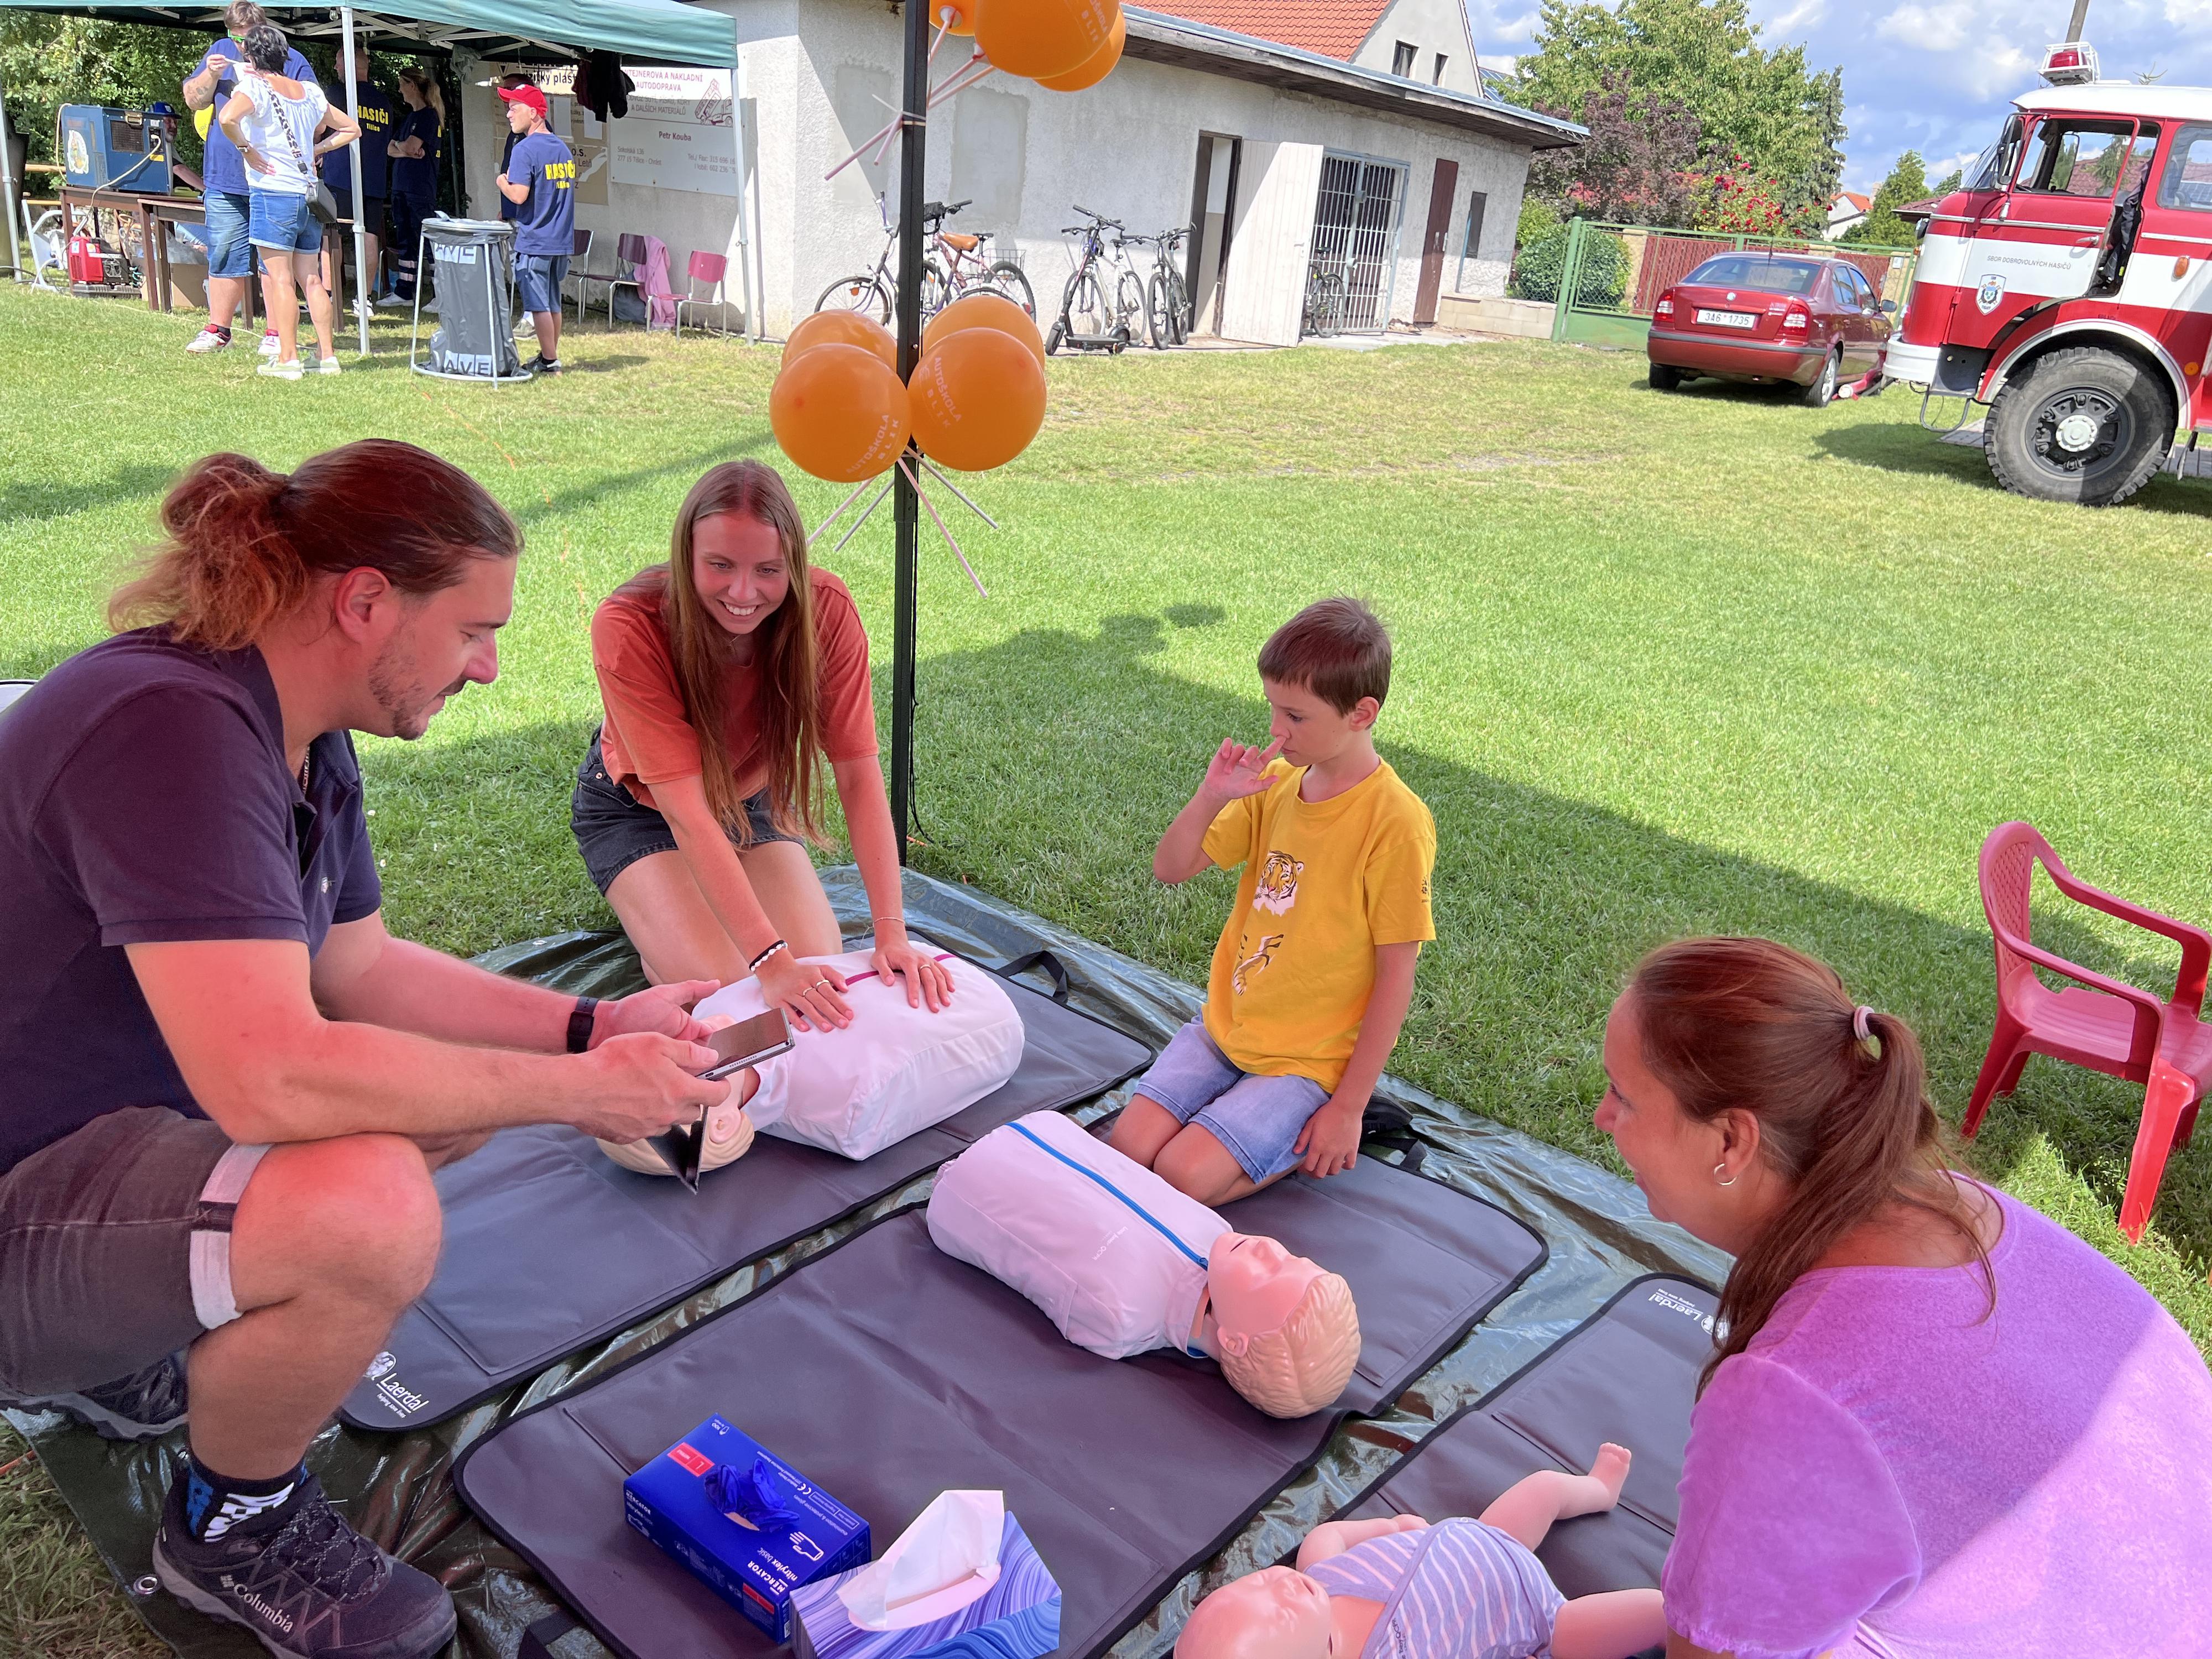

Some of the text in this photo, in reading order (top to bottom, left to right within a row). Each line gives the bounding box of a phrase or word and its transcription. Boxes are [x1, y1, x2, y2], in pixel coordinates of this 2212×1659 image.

[636, 81, 681, 92] AUTODOPRAVA
[659, 131, 692, 141] Petr Kouba
[2002, 257, 2047, 268] DOBROVOLNÝCH
[2048, 261, 2072, 270] HASIČŮ
[1705, 312, 1750, 326] 3A6 1735
[445, 359, 489, 375] AVE
[934, 357, 962, 421] AUTOŠKOLA
[927, 388, 951, 428] BLIK
[846, 414, 889, 473] AUTOŠKOLA
[878, 419, 899, 460] BLIK
[1648, 1293, 1703, 1321] Laerdal
[380, 1373, 430, 1411] Laerdal
[696, 1461, 705, 1469] L
[626, 1491, 651, 1515] MERCATOR
[748, 1561, 786, 1594] MERCATOR
[757, 1547, 797, 1581] nitrylex basic
[234, 1583, 293, 1633] Columbia
